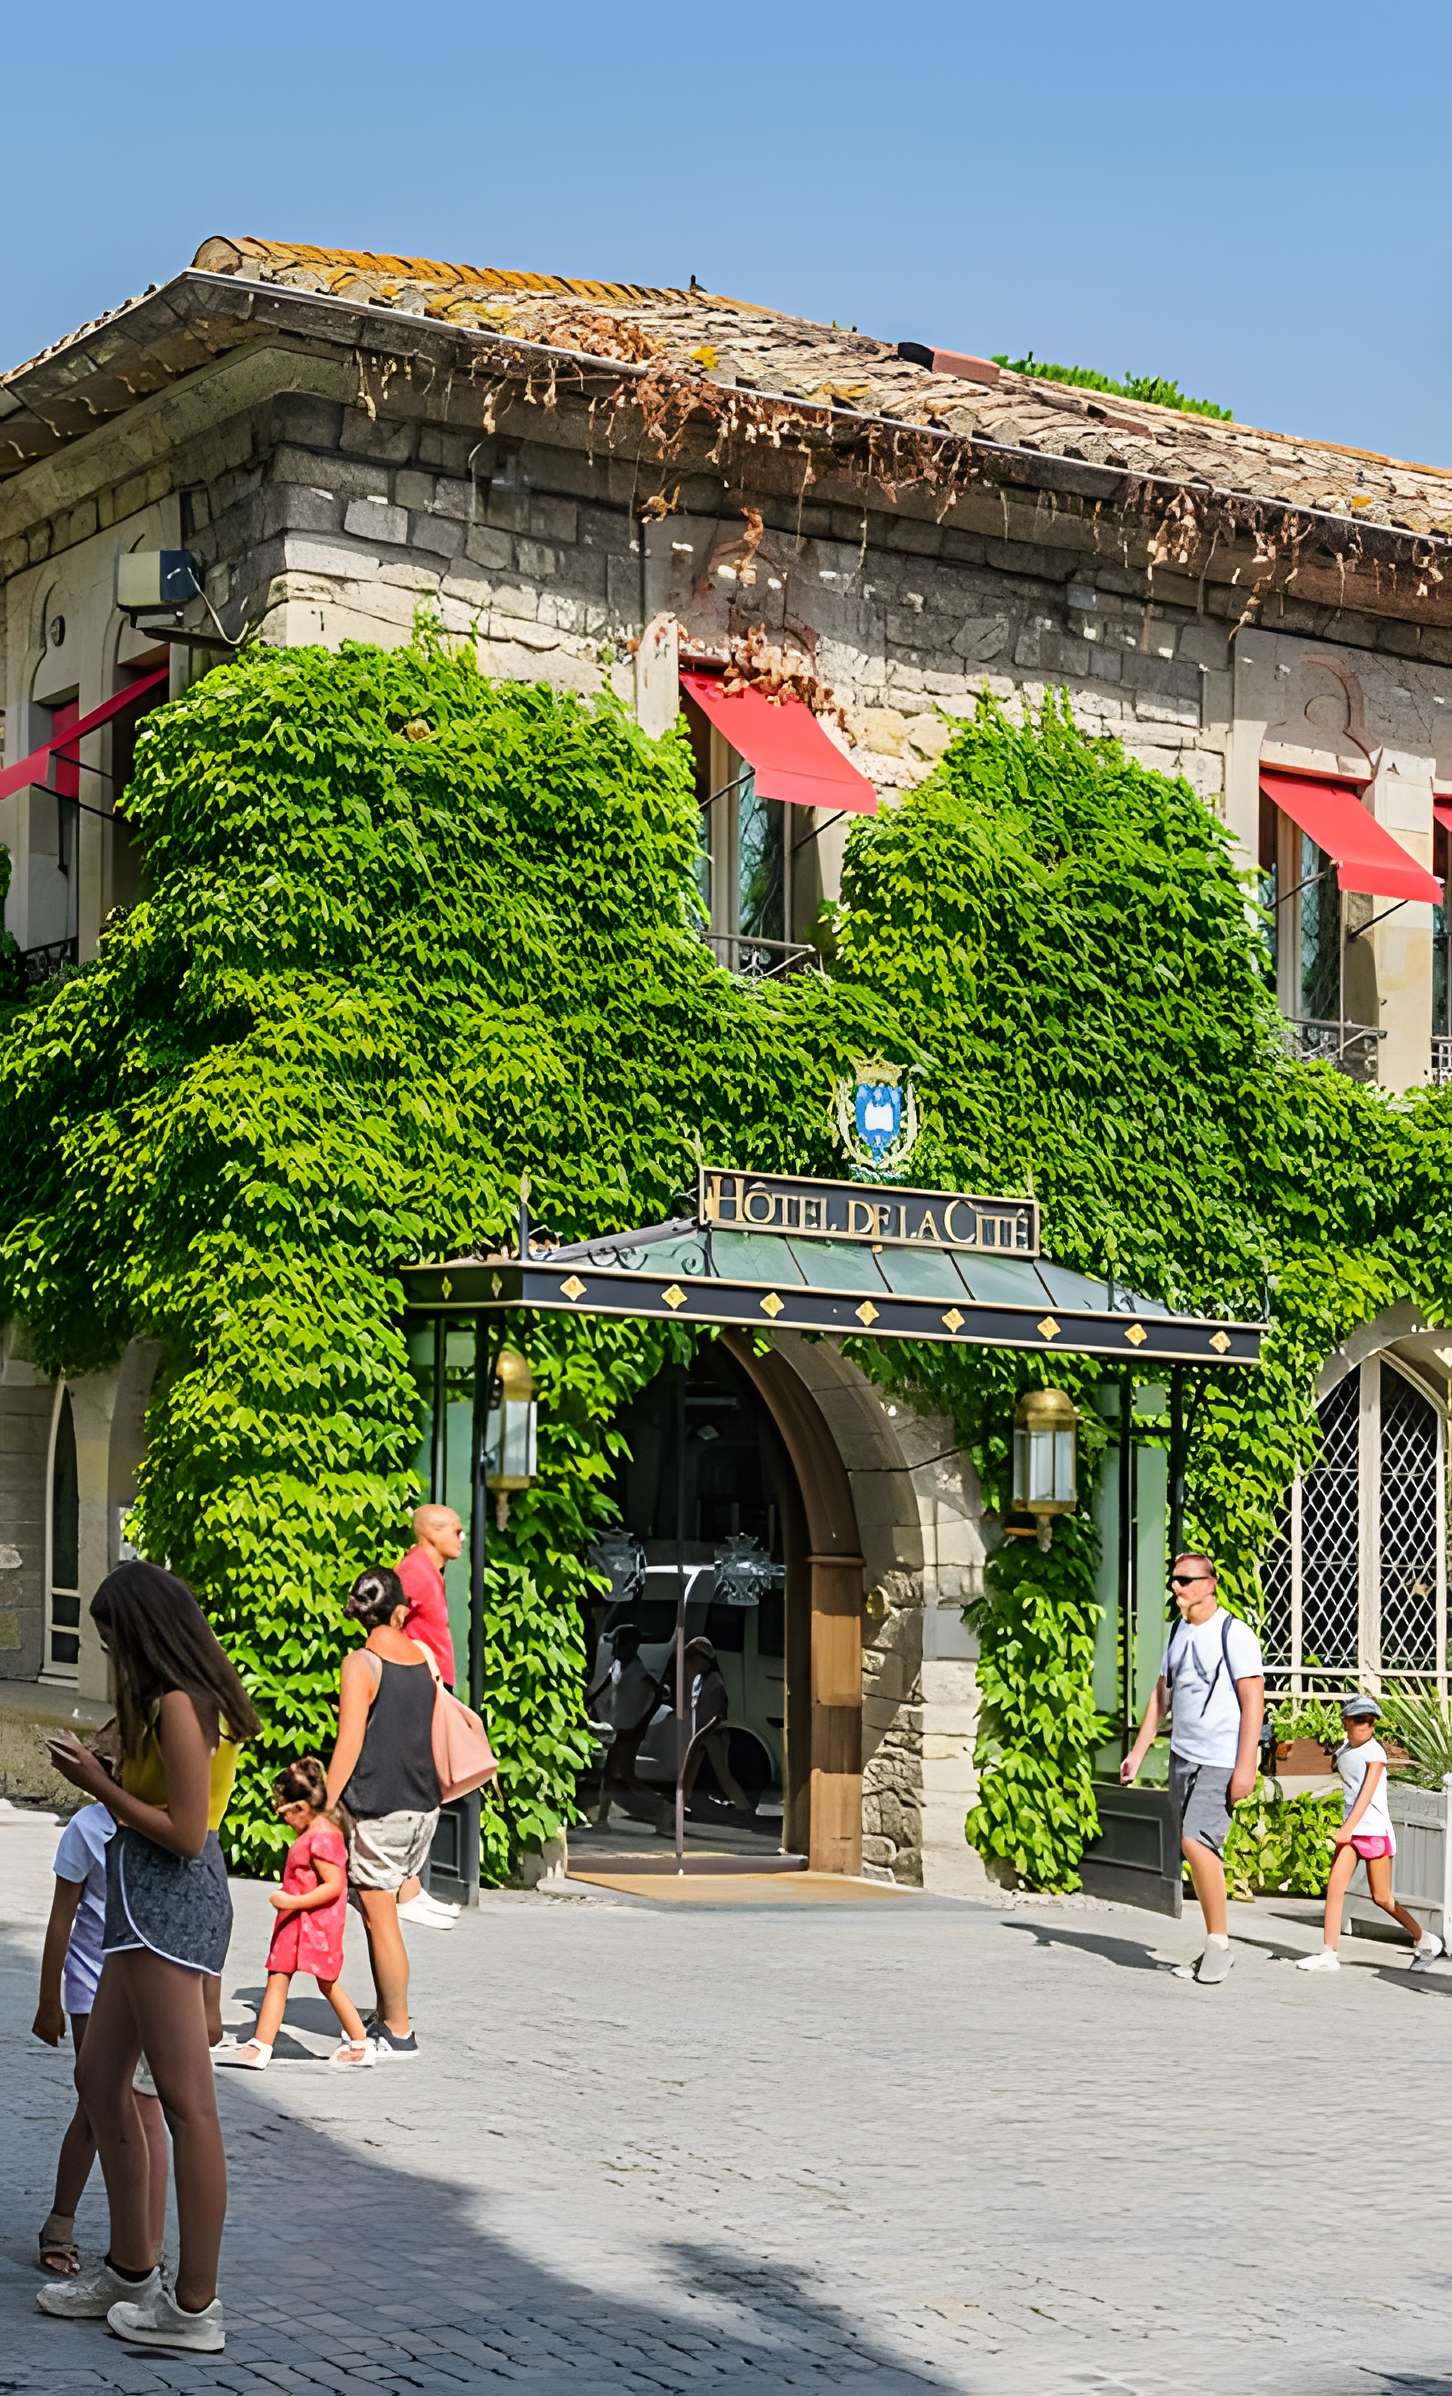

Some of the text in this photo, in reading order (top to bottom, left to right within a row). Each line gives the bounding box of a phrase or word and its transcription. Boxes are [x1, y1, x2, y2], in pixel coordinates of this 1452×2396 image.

[706, 1175, 837, 1231] HÔTEL
[849, 1200, 891, 1236] DE
[900, 1206, 941, 1242] LA
